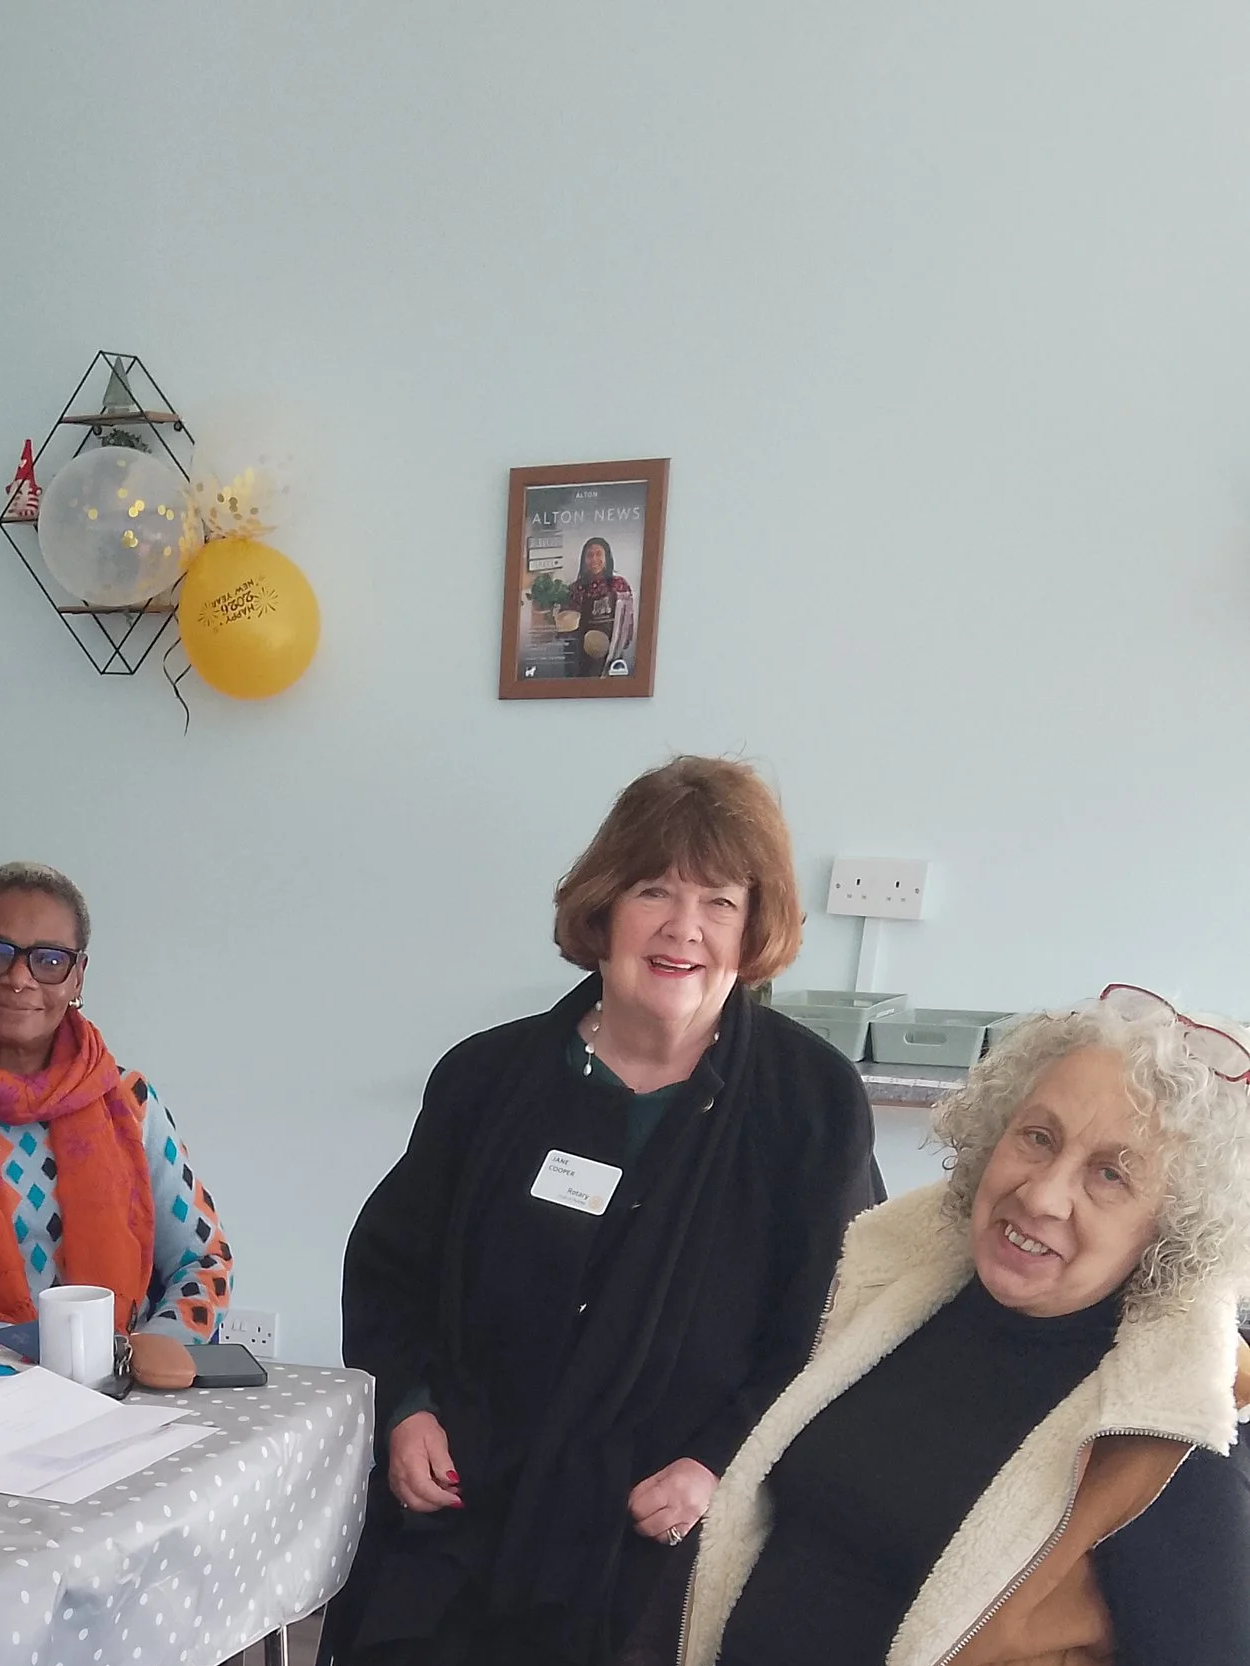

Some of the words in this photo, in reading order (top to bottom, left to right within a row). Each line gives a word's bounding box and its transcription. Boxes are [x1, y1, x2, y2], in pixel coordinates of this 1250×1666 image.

[575, 490, 598, 499] ALTON
[532, 509, 584, 526] ALTON
[594, 506, 640, 521] NEWS
[235, 578, 255, 595] NEW
[211, 592, 233, 608] YEAR
[220, 590, 254, 615] 2026
[225, 603, 255, 624] HAPPY
[552, 1156, 570, 1166] JANE
[548, 1165, 576, 1177] COOPER
[567, 1187, 590, 1201] Rotary
